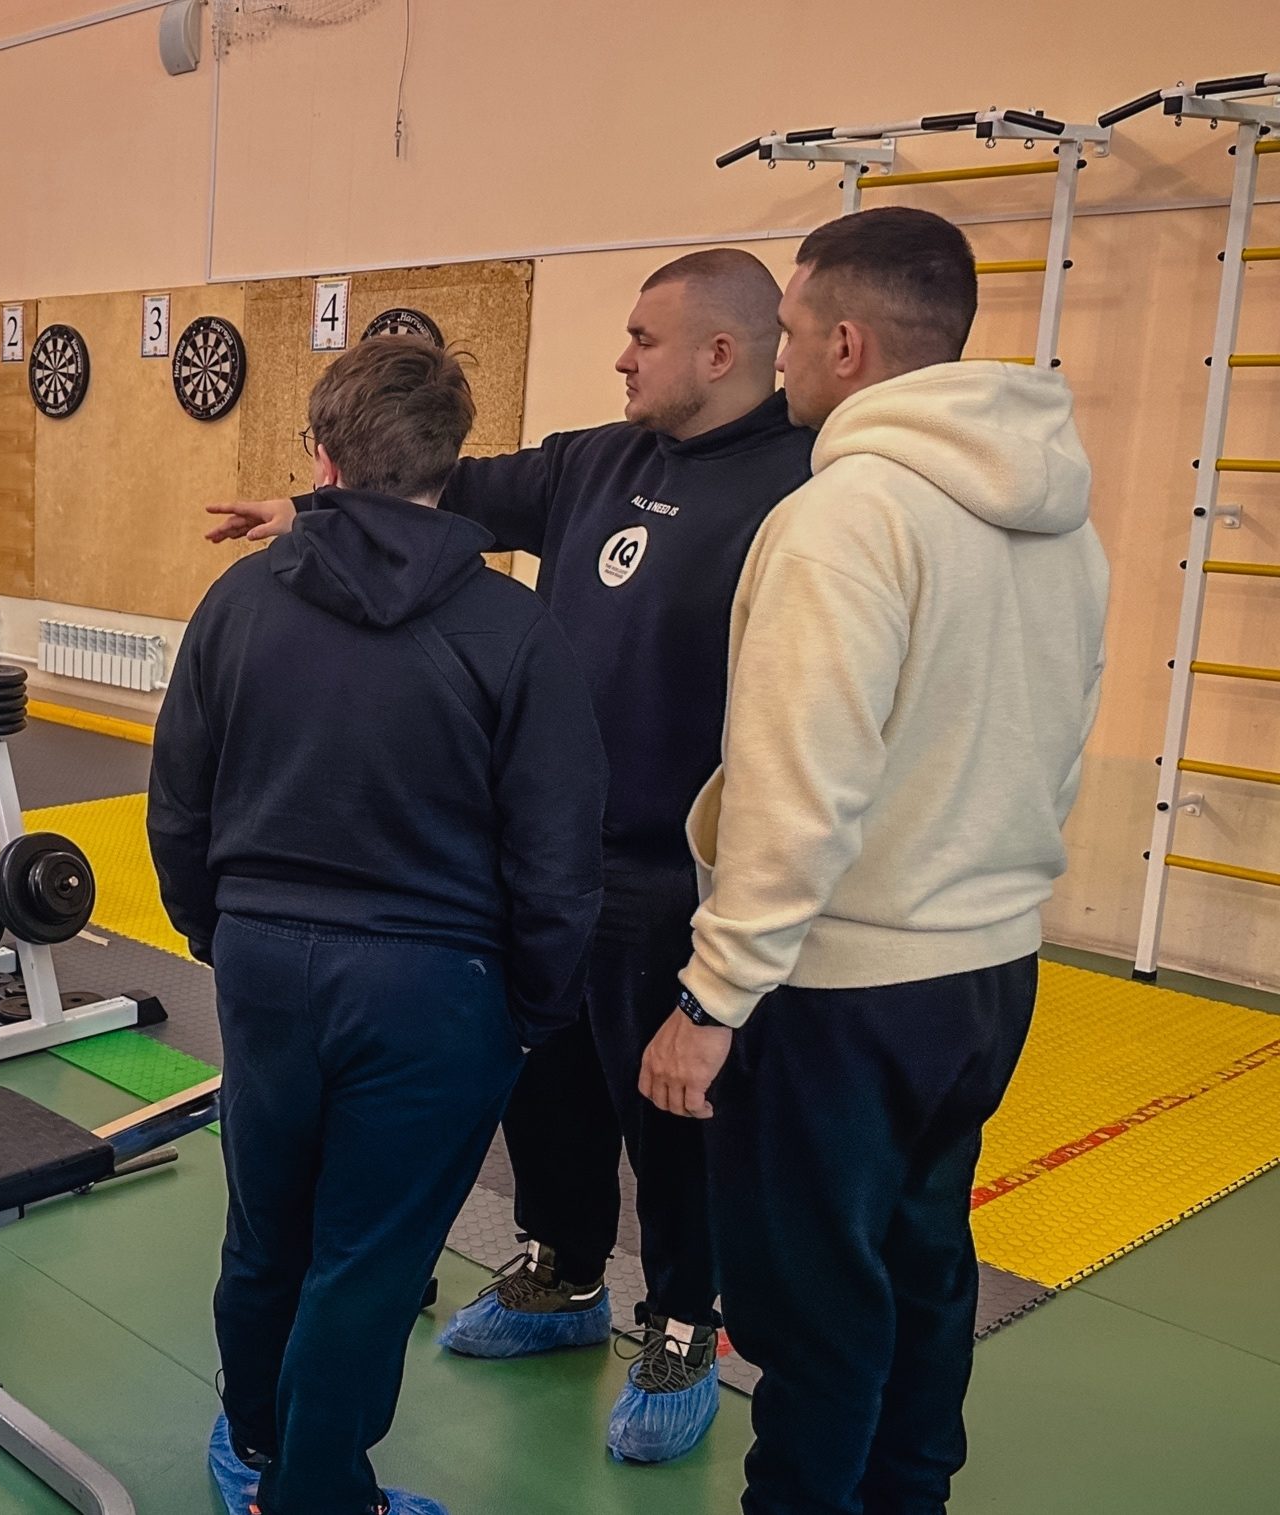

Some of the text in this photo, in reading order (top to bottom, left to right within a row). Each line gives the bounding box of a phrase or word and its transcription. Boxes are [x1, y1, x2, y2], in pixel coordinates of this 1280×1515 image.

[149, 306, 162, 341] 3
[320, 293, 339, 332] 4
[7, 316, 18, 347] 2
[631, 495, 648, 509] ALL
[608, 536, 639, 569] IQ
